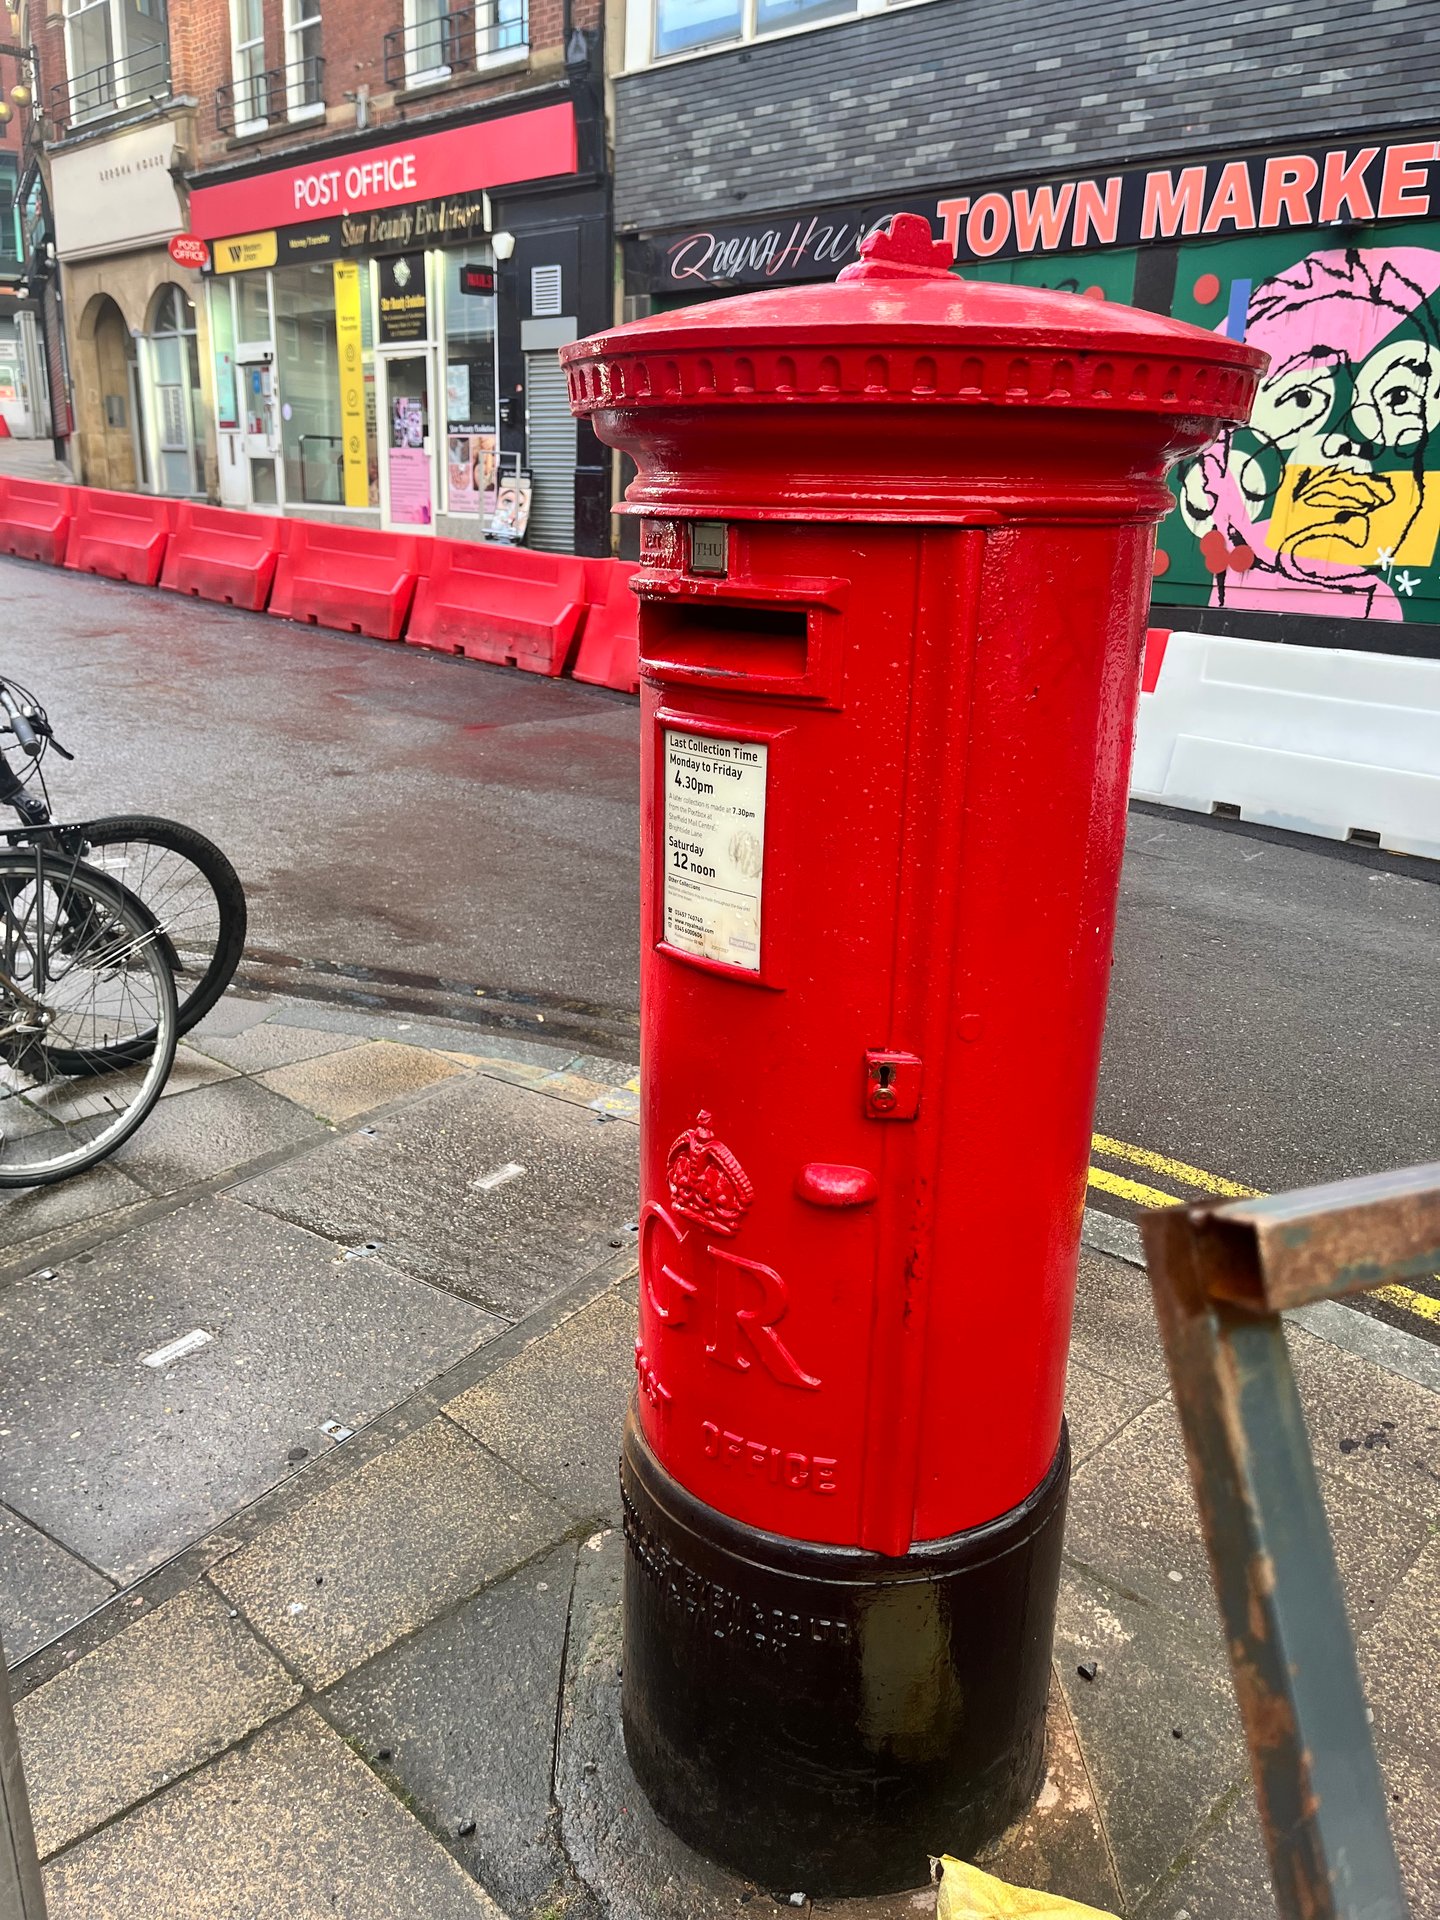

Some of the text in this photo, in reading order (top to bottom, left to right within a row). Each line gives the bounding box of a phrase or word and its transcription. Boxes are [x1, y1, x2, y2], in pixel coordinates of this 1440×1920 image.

[294, 154, 416, 209] POST OFFICE
[936, 141, 1440, 260] TOWN MARKE
[341, 202, 481, 247] Star Beauty Evolution
[172, 240, 205, 261] POST OFFICE
[695, 542, 722, 556] THU
[670, 735, 758, 762] Last Collection Time
[670, 753, 743, 780] Monday to Friday
[675, 769, 714, 794] 4.30pm
[669, 812, 688, 824] Sheffield
[688, 818, 698, 827] Mail
[683, 797, 705, 808] collection
[711, 803, 726, 812] made
[732, 807, 756, 818] 7.30pm
[688, 807, 706, 818] Postbox
[669, 822, 703, 839] Brightside Lane
[669, 835, 704, 857] Saturday
[673, 851, 716, 878] 12 noon
[668, 875, 679, 884] Other
[679, 879, 701, 891] Collections
[635, 1200, 822, 1392] GR
[701, 1420, 838, 1495] OFFICE
